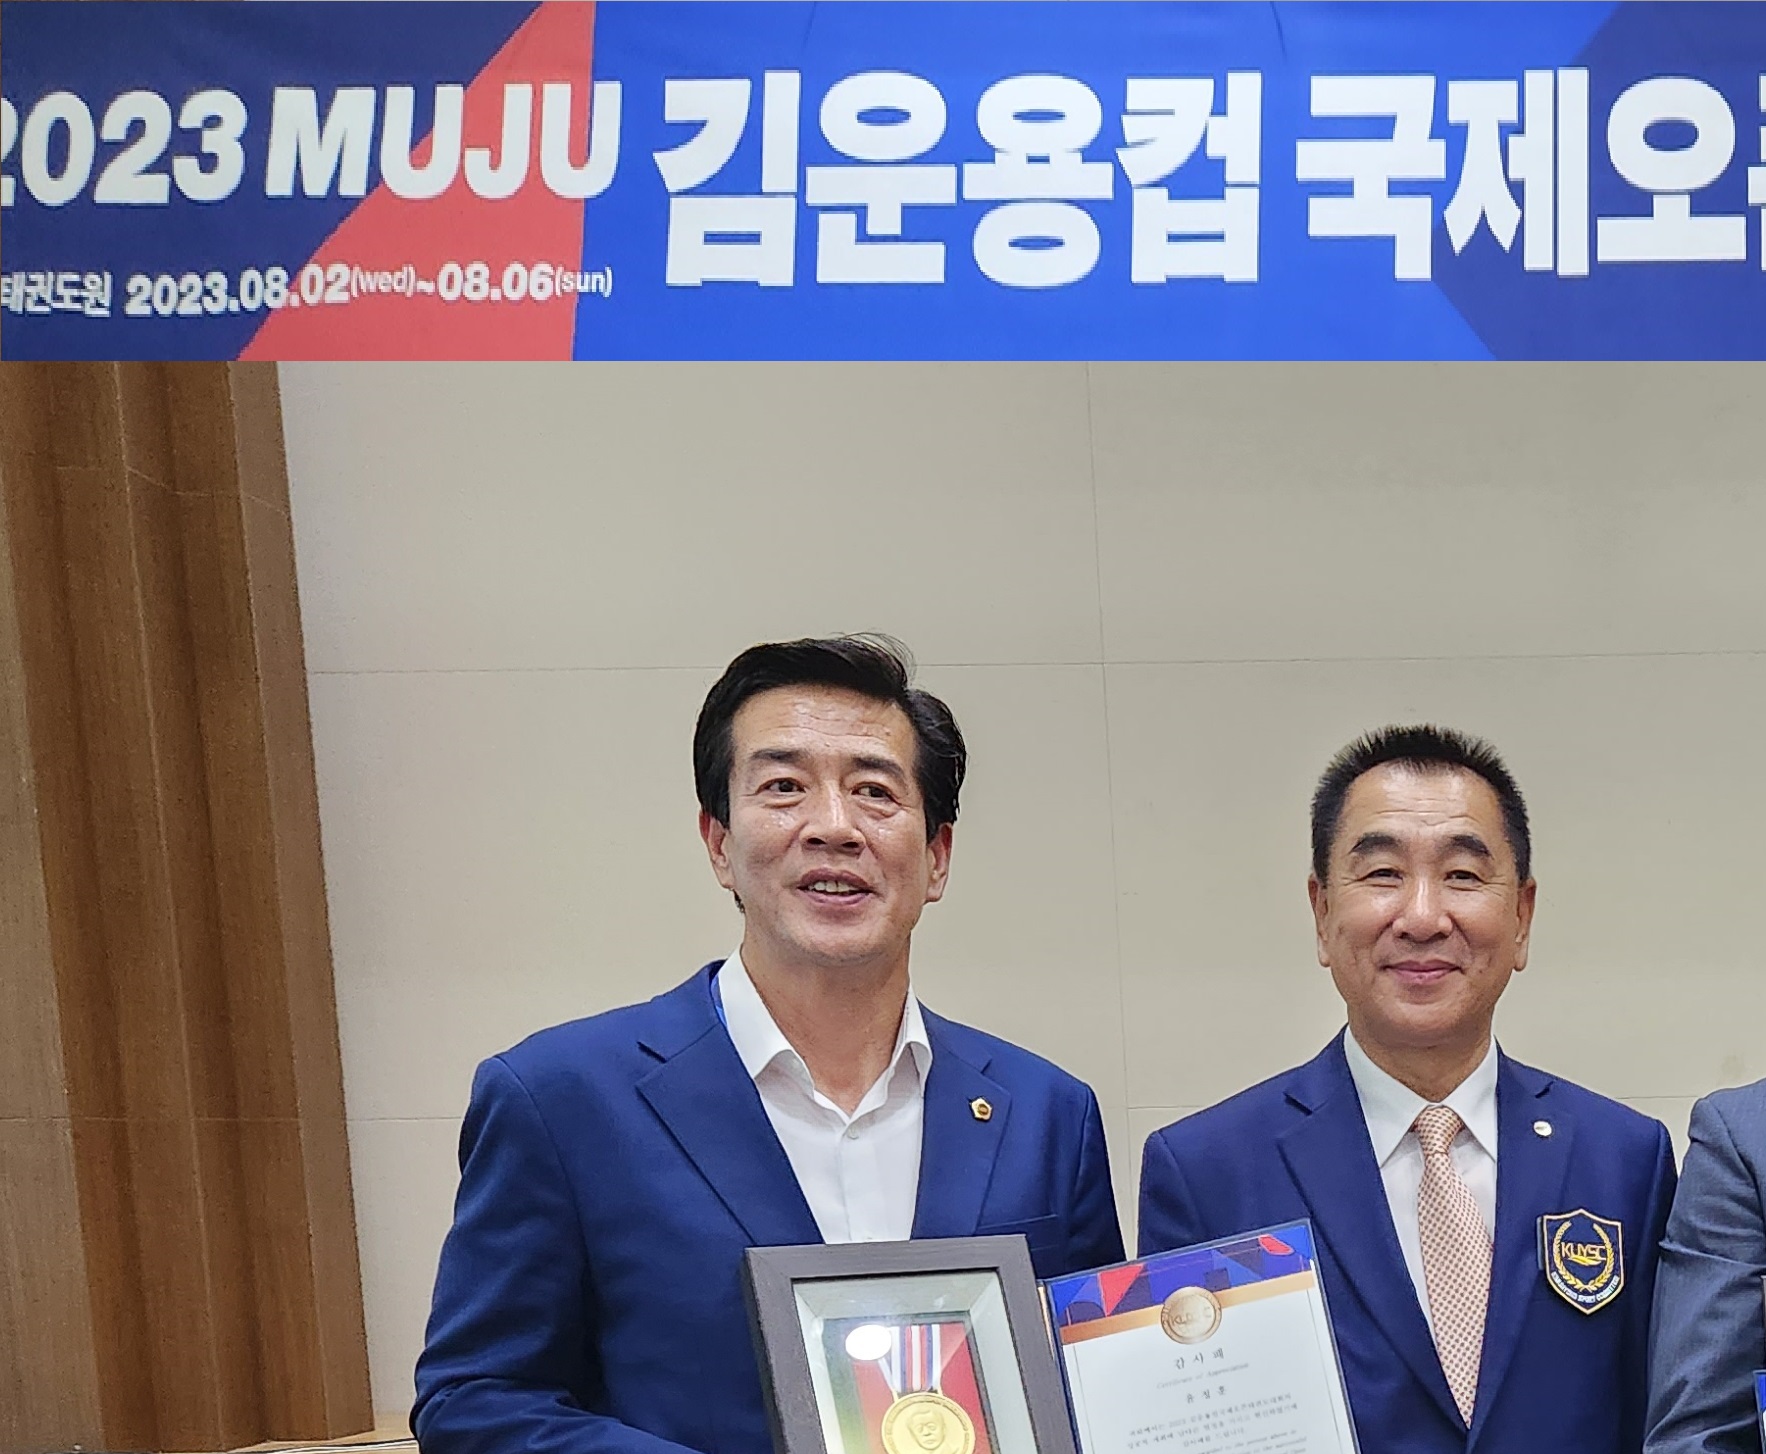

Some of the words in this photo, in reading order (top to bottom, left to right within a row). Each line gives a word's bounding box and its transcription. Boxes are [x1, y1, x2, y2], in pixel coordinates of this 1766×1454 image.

[0, 88, 249, 207] 023
[265, 81, 623, 200] MUJU
[651, 69, 1263, 289] 김운용컵
[0, 270, 112, 318] 태권도원
[124, 263, 613, 316] 2023.08.02(wed)~08.06(sun)
